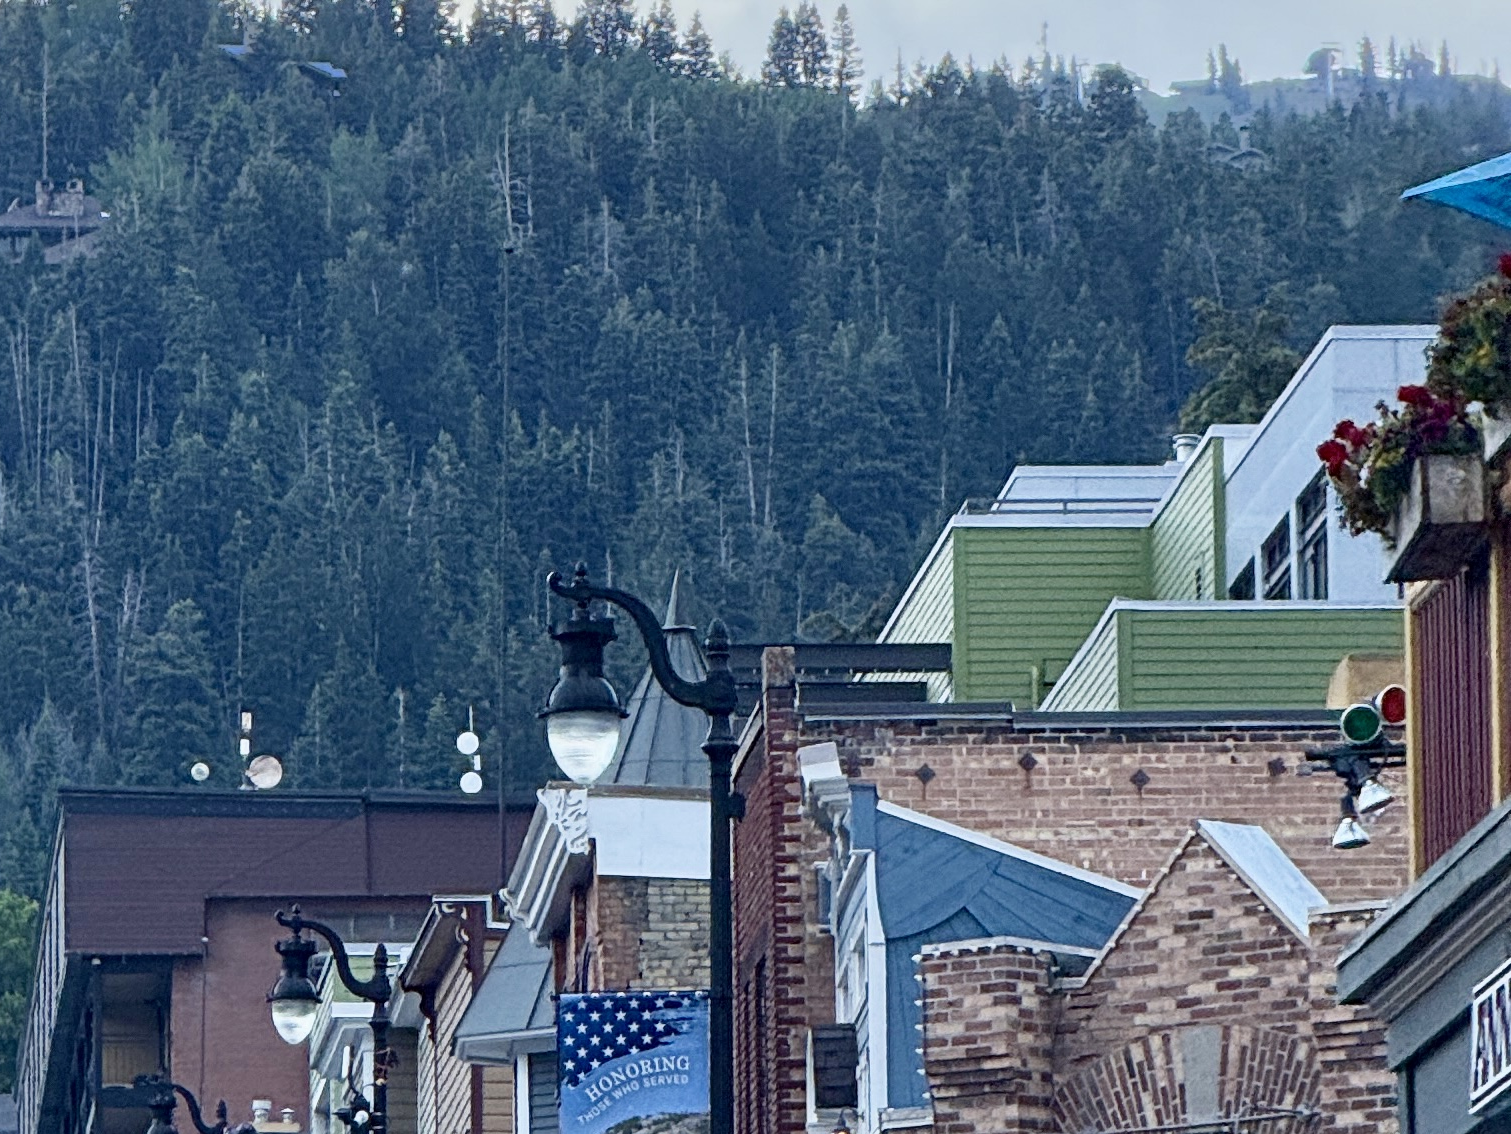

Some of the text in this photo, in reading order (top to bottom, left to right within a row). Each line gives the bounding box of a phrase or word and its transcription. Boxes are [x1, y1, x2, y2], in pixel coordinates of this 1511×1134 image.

[578, 1074, 689, 1124] THOSE WHO SERVED
[585, 1056, 690, 1102] HONORING
